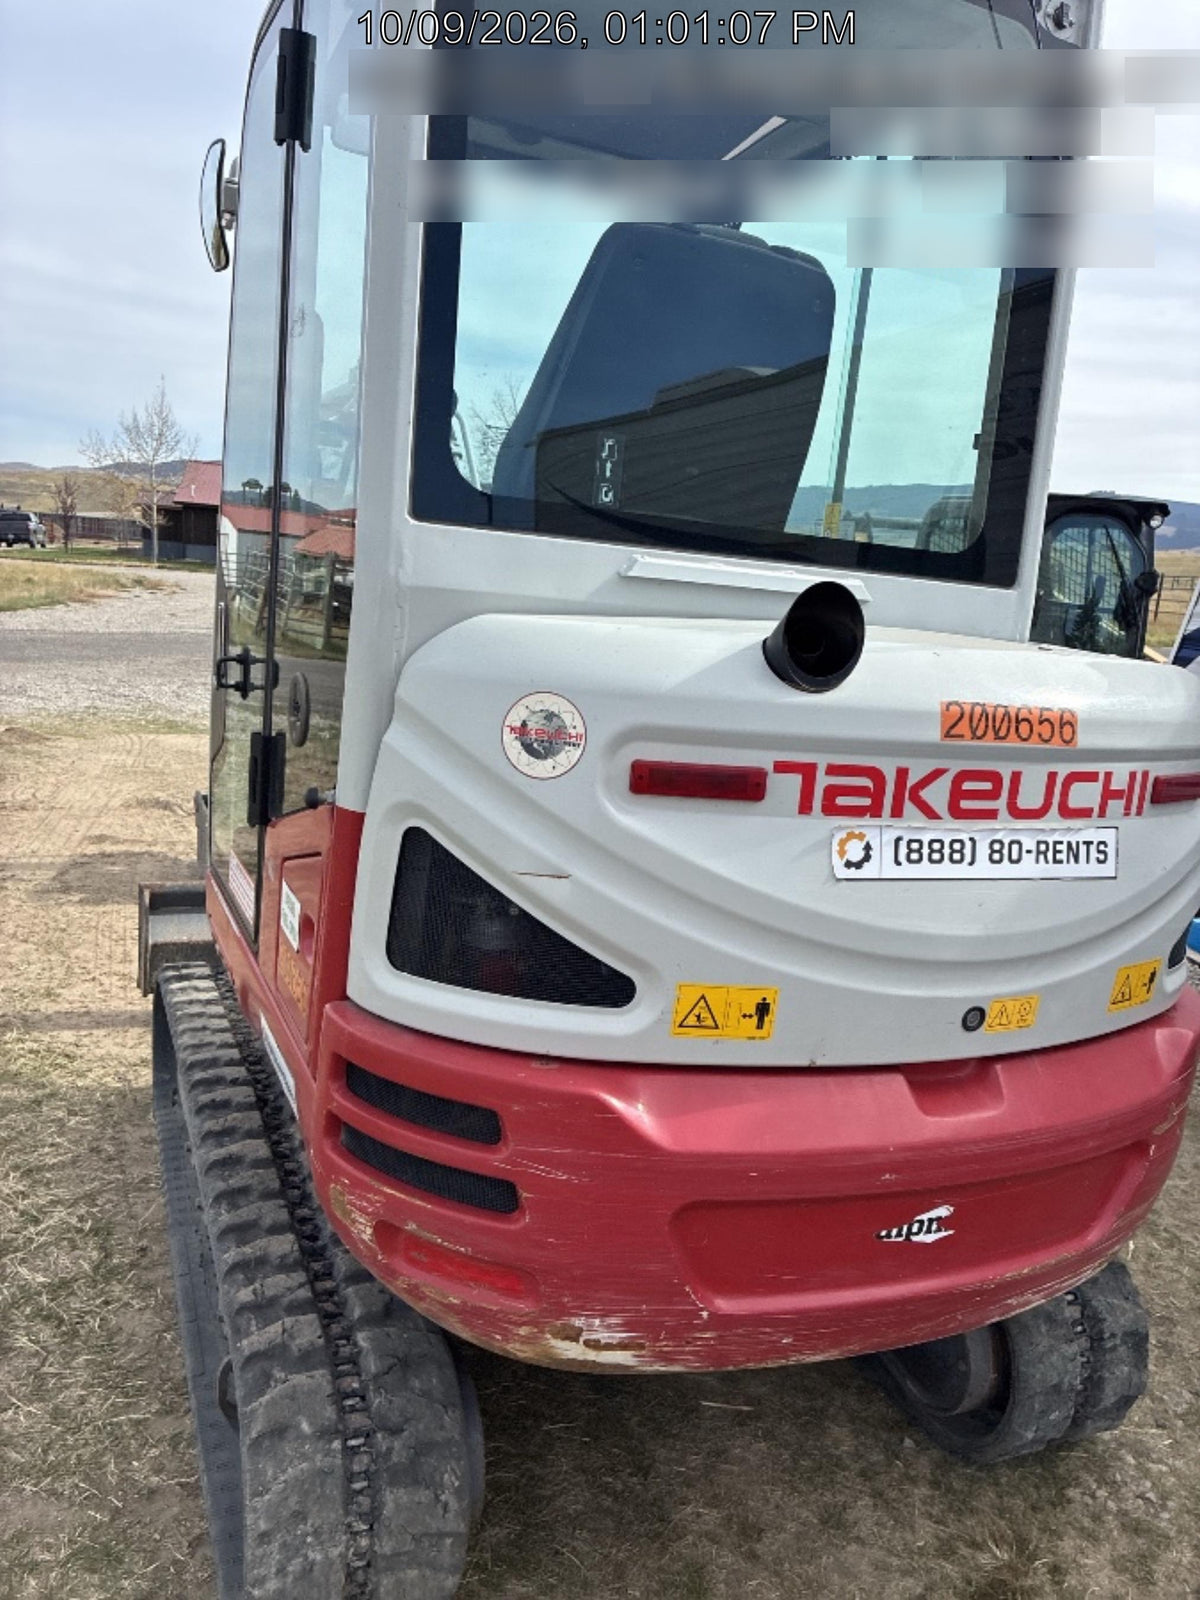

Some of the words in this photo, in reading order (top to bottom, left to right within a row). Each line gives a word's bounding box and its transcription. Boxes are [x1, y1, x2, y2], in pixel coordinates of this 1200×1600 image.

[942, 700, 1077, 744] 200656
[892, 836, 978, 866] (888)
[987, 838, 1110, 866] 80-RENTS
